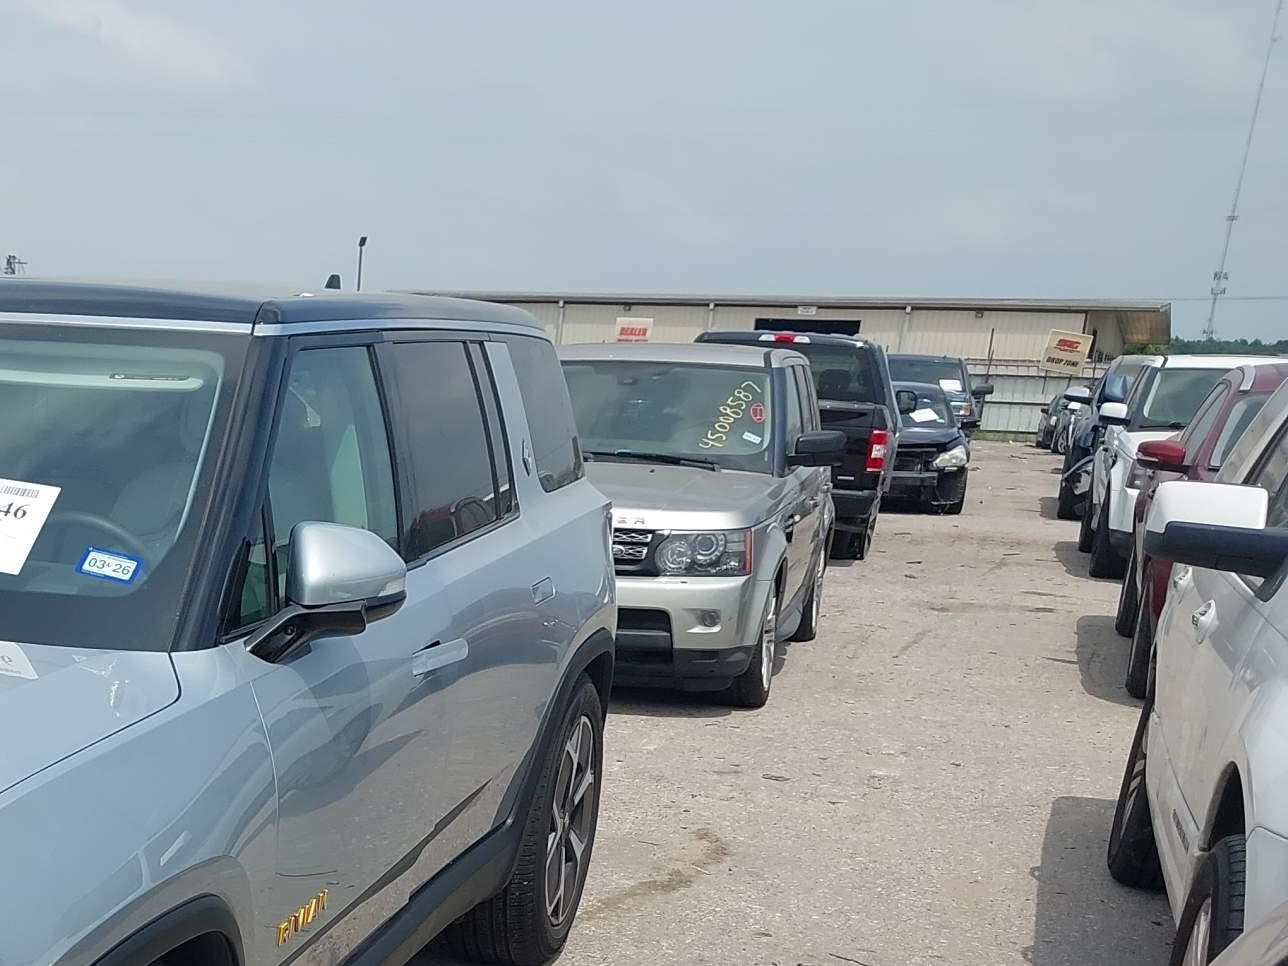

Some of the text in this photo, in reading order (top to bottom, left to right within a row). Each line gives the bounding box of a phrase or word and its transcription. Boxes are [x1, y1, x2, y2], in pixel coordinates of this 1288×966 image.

[1046, 356, 1079, 367] DROP ZONE
[698, 381, 762, 448] 45008587
[88, 557, 132, 575] 03 26
